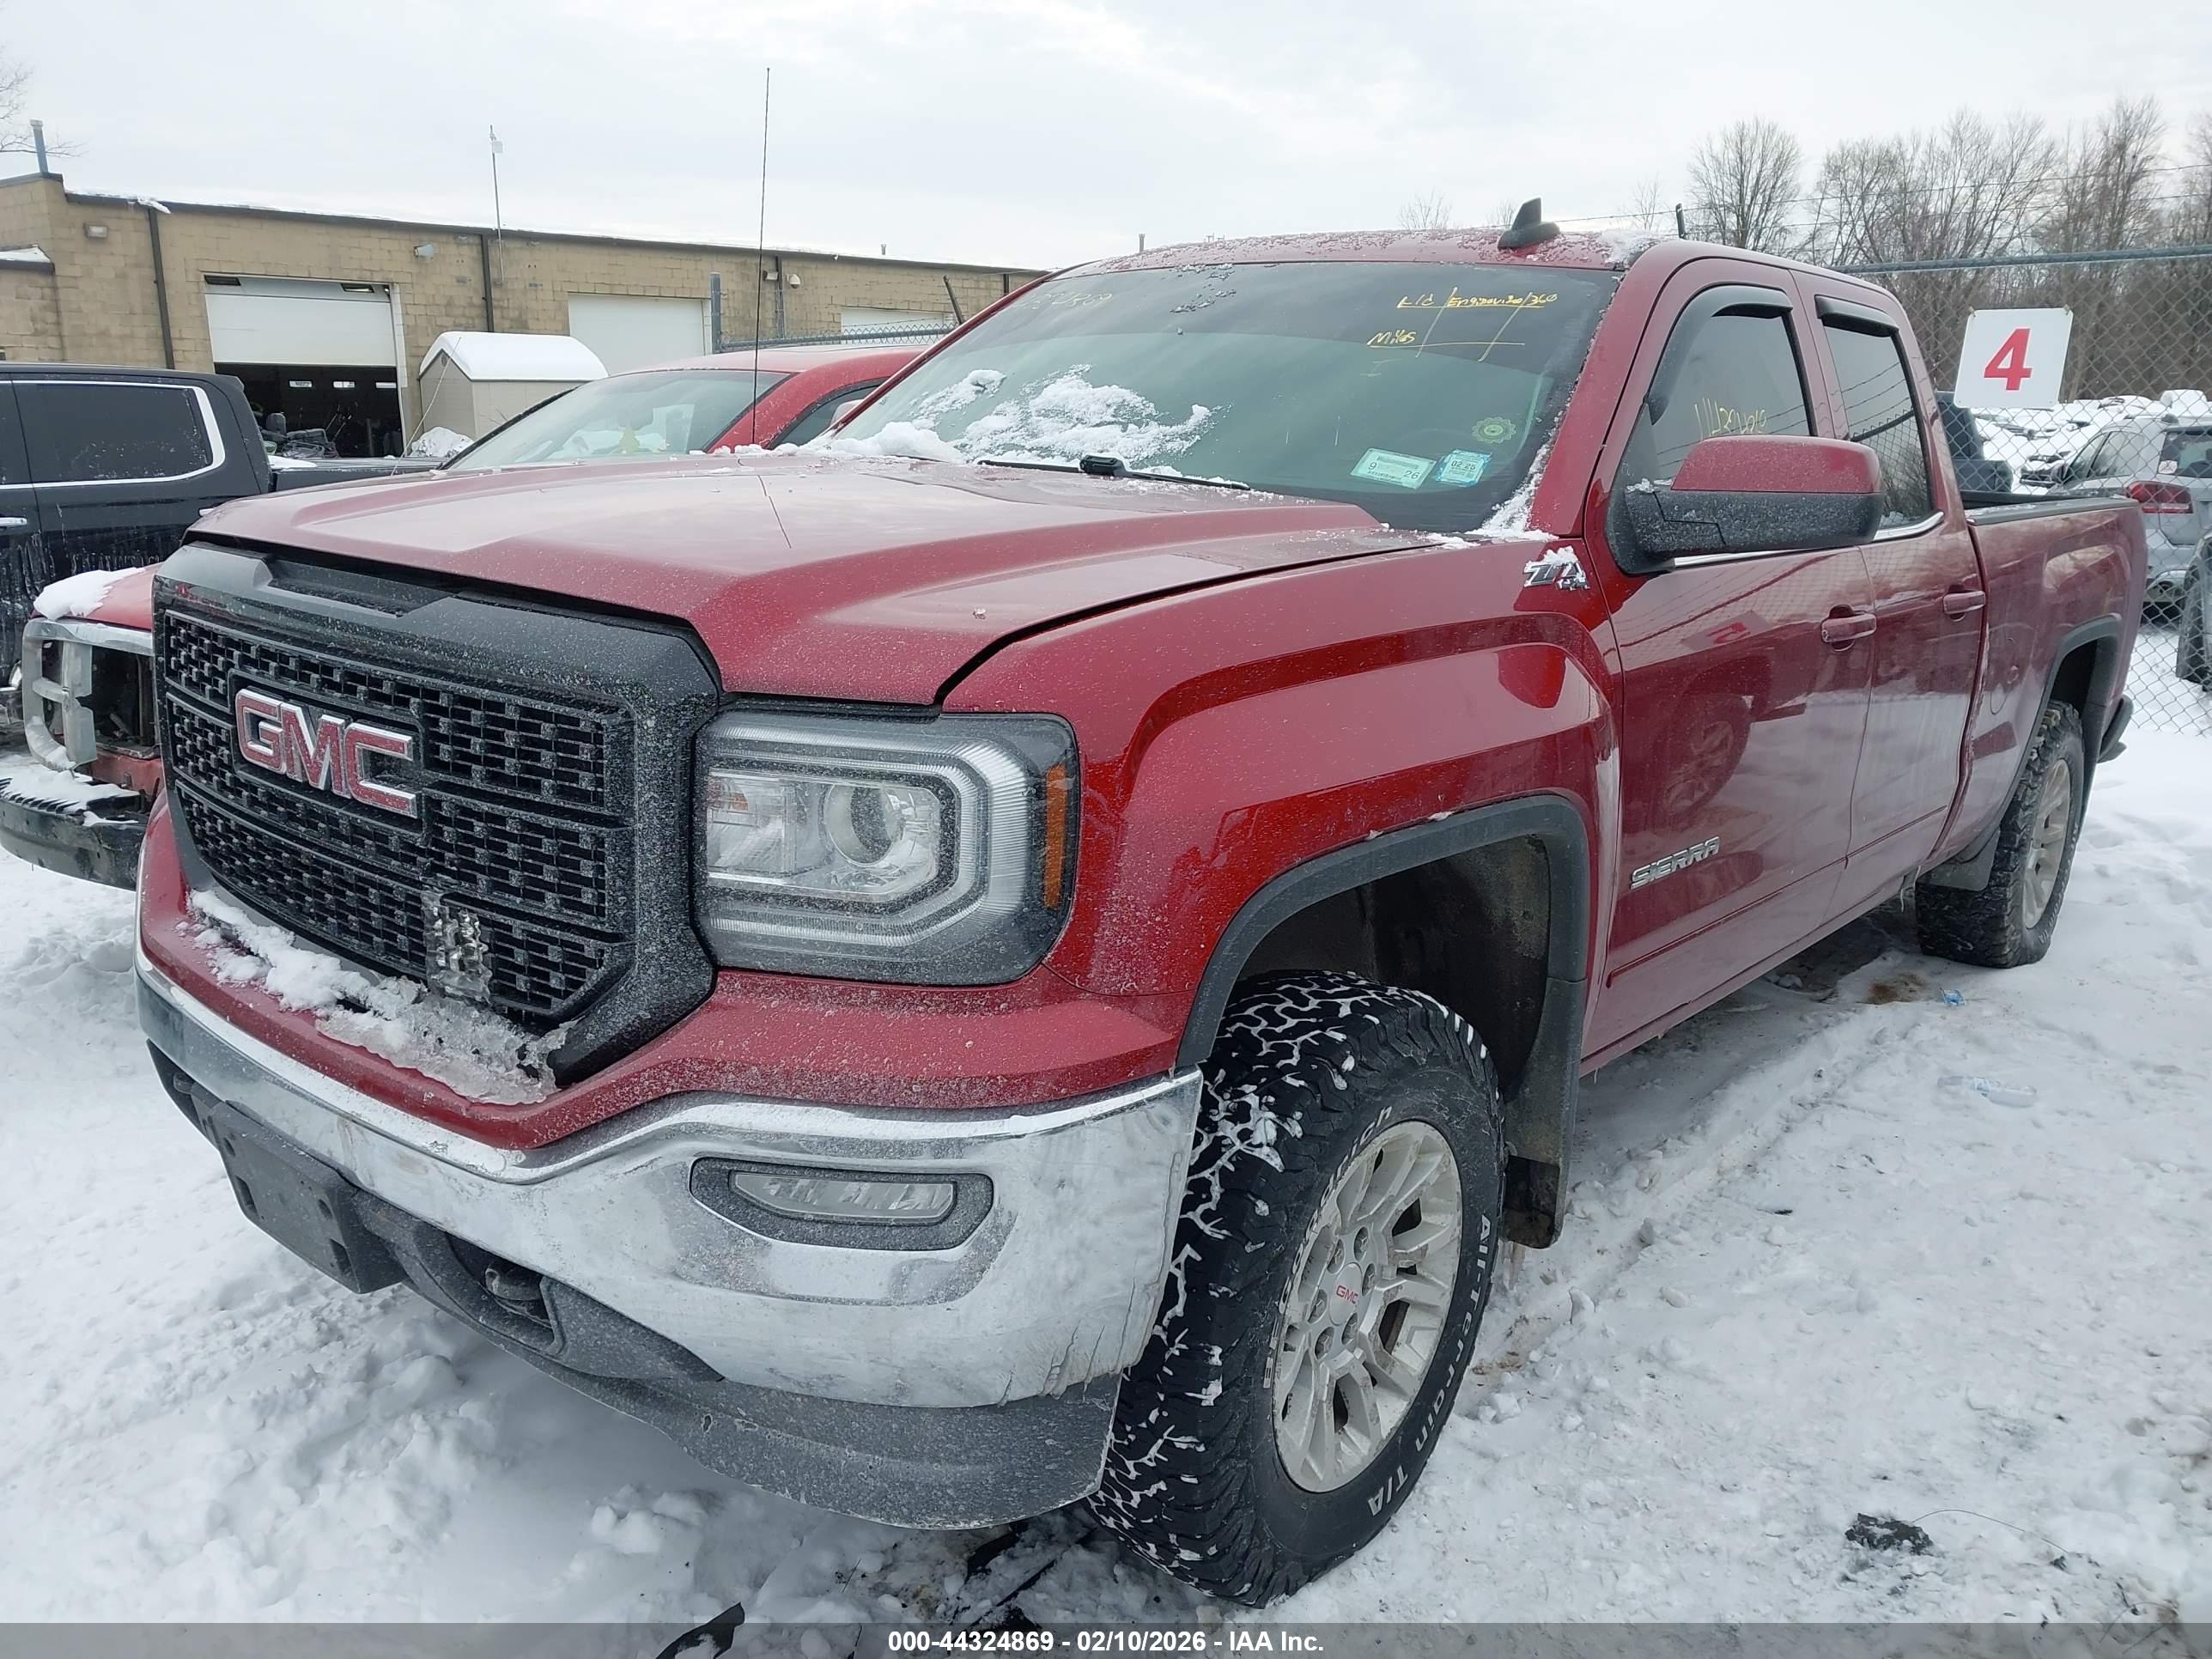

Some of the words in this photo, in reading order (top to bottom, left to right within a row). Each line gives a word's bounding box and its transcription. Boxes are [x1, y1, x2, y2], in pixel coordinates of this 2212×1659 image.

[1984, 328, 2033, 391] 4
[1368, 461, 1377, 471] 9
[1403, 470, 1419, 480] 26
[235, 689, 417, 818] GMC
[1631, 836, 1720, 890] SIERRA
[1336, 1285, 1358, 1304] GMC
[1415, 1213, 1492, 1452] All-Terrain
[1367, 1465, 1408, 1516] T/A
